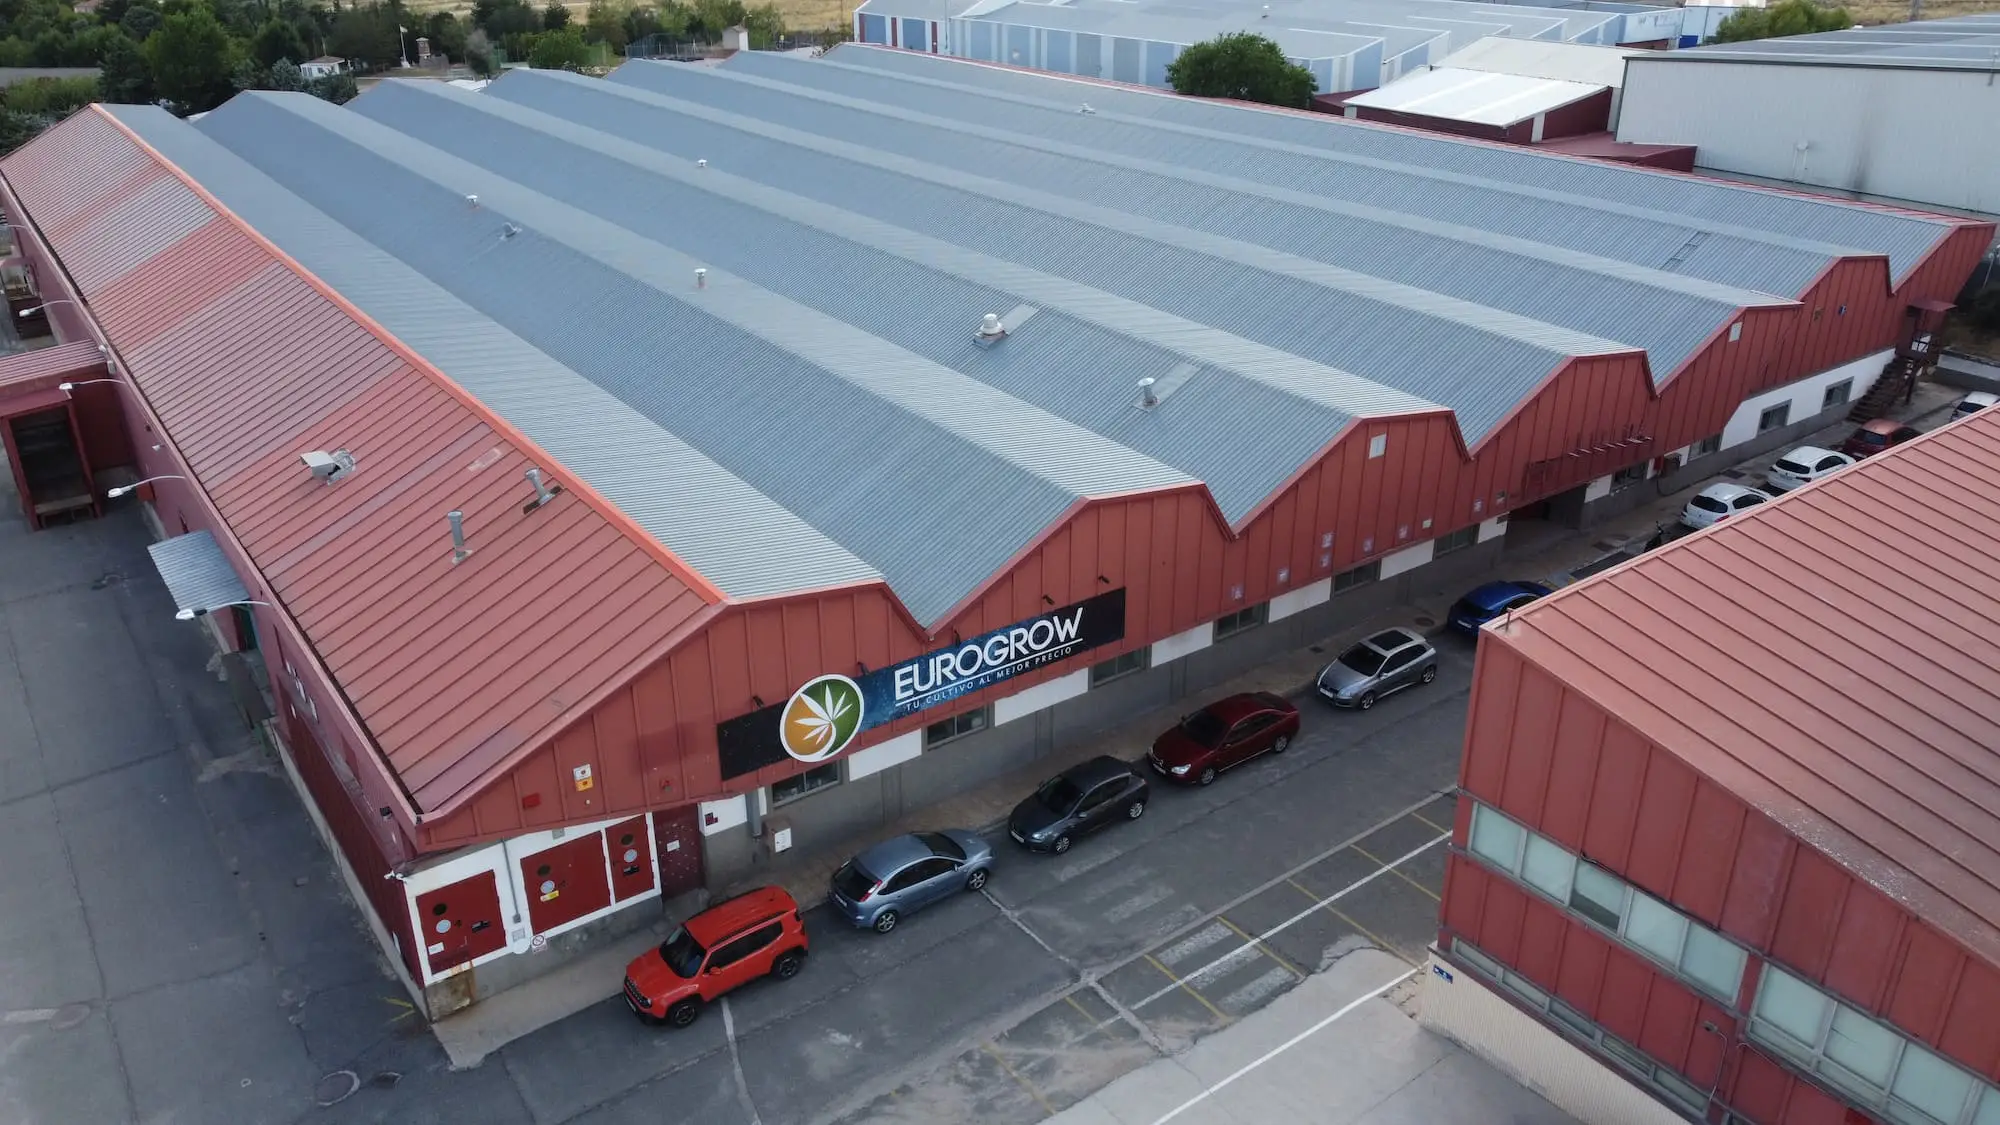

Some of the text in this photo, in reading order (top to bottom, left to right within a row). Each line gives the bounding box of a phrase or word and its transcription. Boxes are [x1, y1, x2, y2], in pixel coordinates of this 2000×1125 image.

[894, 607, 1083, 701] EUROGROW
[906, 646, 1072, 711] TU CULTIVO AL MEJOR PRECIO
